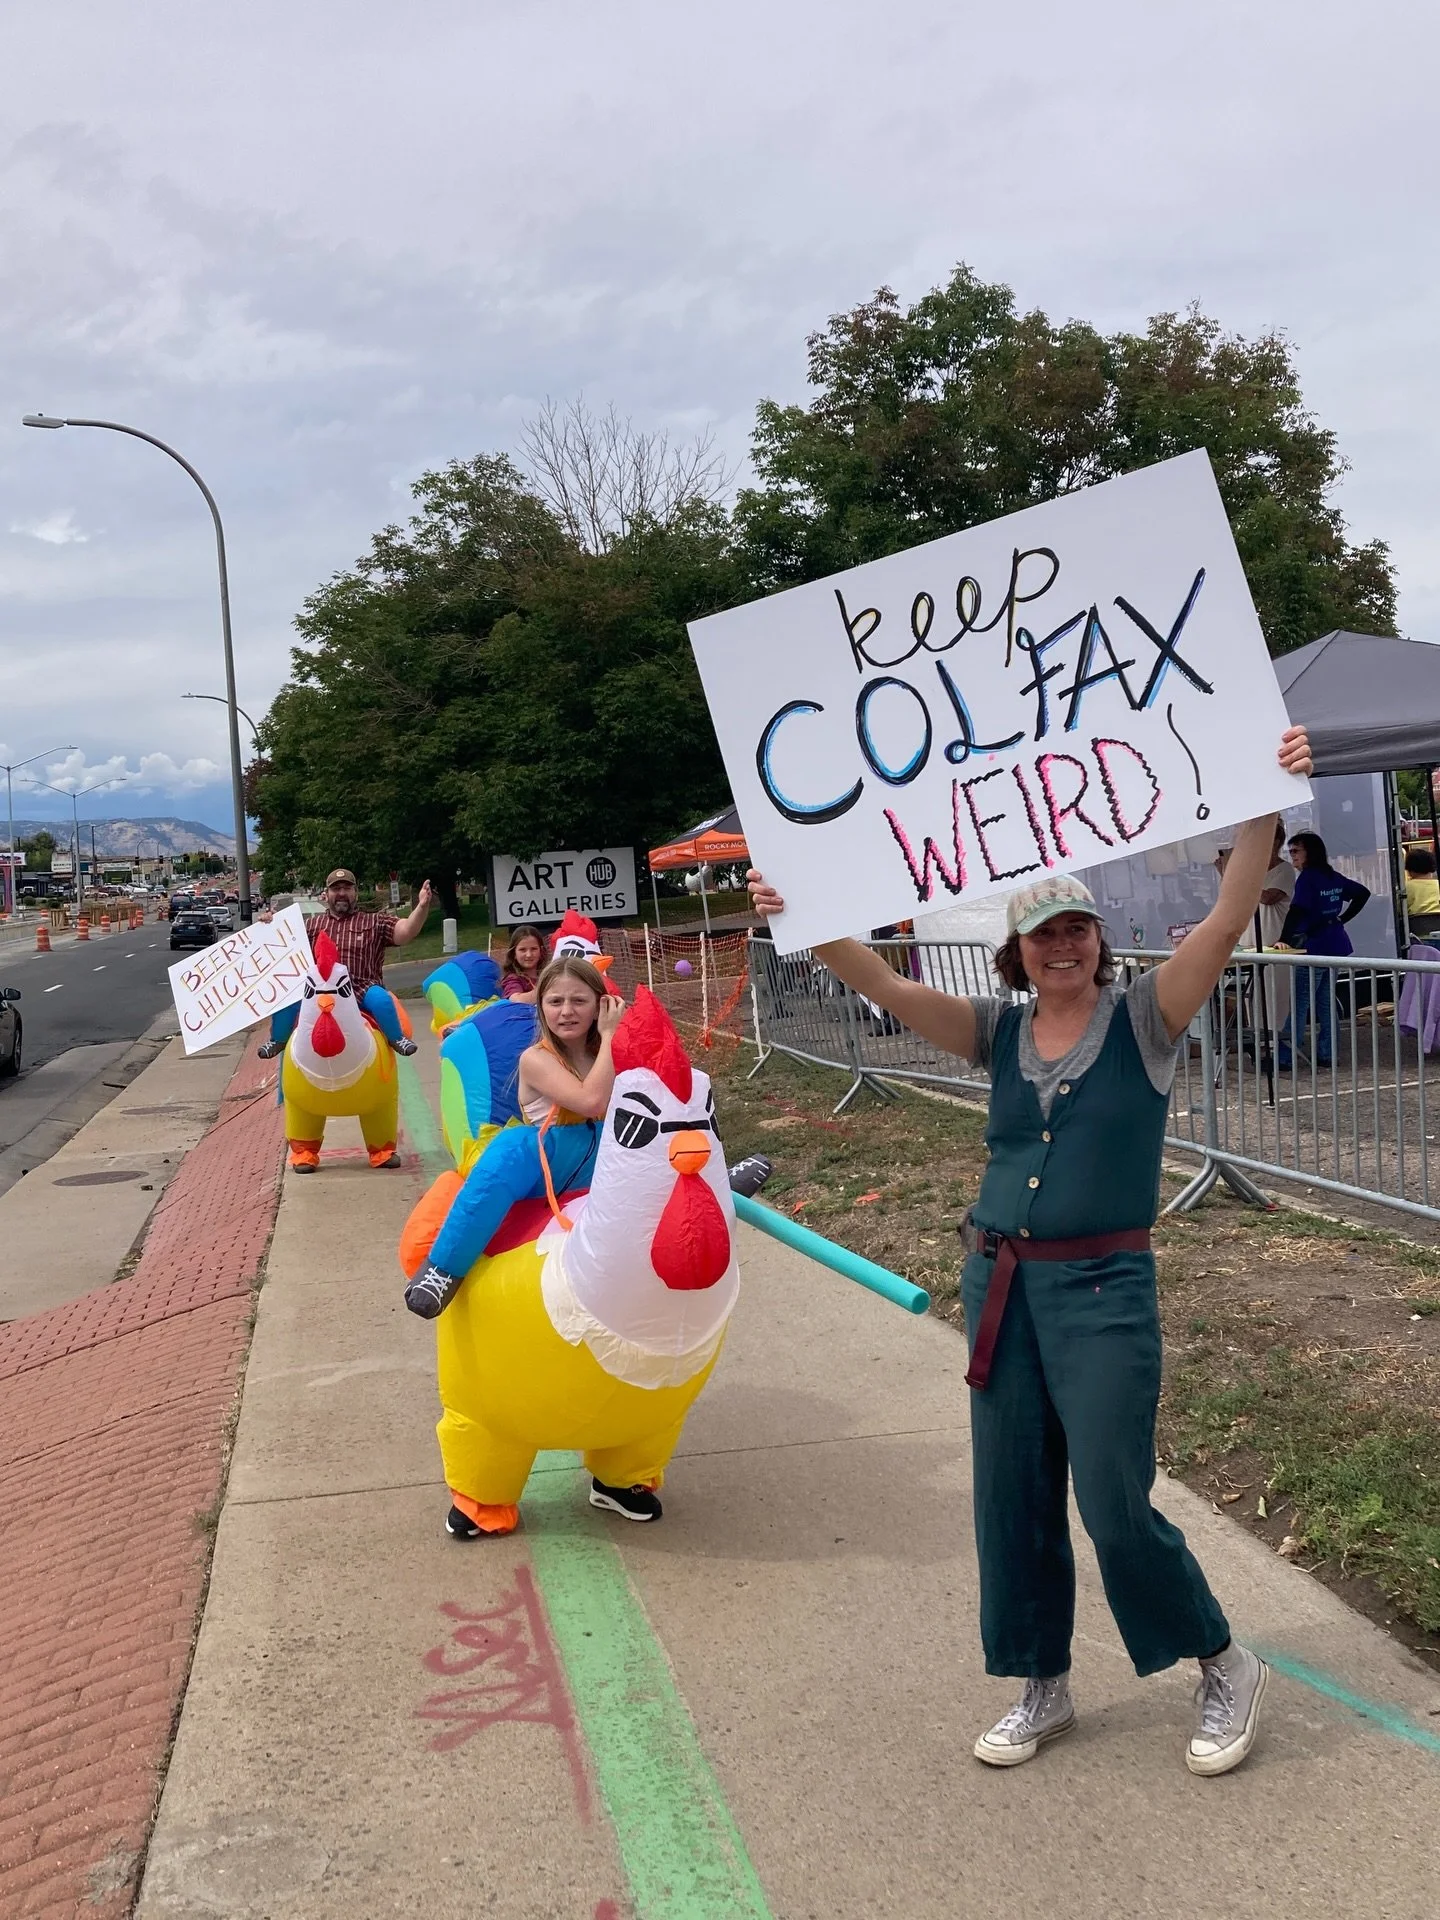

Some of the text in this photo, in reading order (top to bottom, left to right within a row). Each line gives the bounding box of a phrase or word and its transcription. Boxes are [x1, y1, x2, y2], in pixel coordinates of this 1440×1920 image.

[755, 566, 1214, 825] COLFAX
[883, 703, 1210, 902] WEIRD!
[704, 842, 729, 851] ROCKY
[507, 861, 574, 893] ART
[589, 863, 613, 882] HUB
[508, 892, 626, 918] GALLERIES
[180, 930, 252, 992] BEER!!
[184, 919, 296, 1031] CHICKEN!
